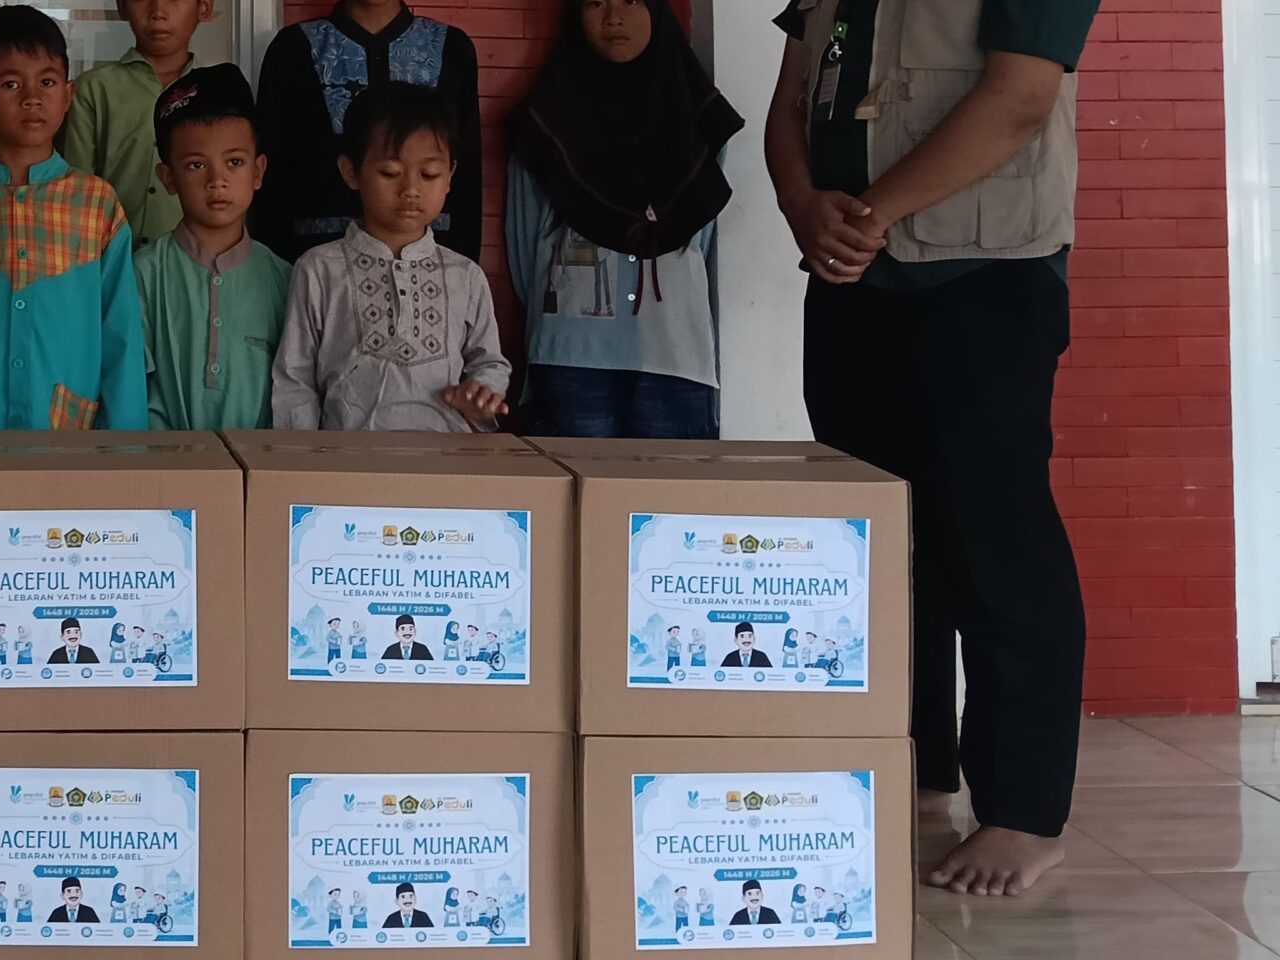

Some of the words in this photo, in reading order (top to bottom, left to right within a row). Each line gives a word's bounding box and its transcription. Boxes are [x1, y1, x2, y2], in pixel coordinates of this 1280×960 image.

[77, 570, 175, 590] MUHARAM
[311, 566, 404, 587] PEACEFUL
[412, 568, 510, 589] MUHARAM
[650, 574, 744, 594] PEACEFUL
[752, 576, 848, 596] MUHARAM
[8, 593, 53, 601] LEBARAN
[56, 593, 87, 601] YATIM
[99, 592, 141, 600] DIFABEL
[342, 589, 388, 597] LEBARAN
[391, 590, 422, 598] YATIM
[424, 590, 431, 598] &
[433, 591, 475, 599] DIFABEL
[682, 597, 728, 605] LEBARAN
[730, 598, 761, 606] YATIM
[763, 598, 770, 606] &
[773, 598, 814, 606] DIFABEL
[42, 608, 62, 616] 1448
[63, 608, 71, 616] H
[78, 608, 99, 616] 2026
[377, 604, 397, 612] 1448
[413, 605, 434, 613] 2026
[716, 612, 736, 620] 1448
[737, 612, 745, 620] H
[752, 612, 773, 620] 2026
[79, 830, 178, 850] MUHARAM
[655, 833, 750, 854] PEACEFUL
[757, 830, 855, 852] MUHARAM
[311, 836, 404, 856] PEACEFUL
[412, 835, 509, 855] MUHARAM
[8, 852, 54, 860] LEBARAN
[57, 852, 88, 860] YATIM
[90, 852, 97, 860] &
[100, 852, 142, 860] DIFABEL
[688, 856, 734, 864] LEBARAN
[737, 855, 767, 863] YATIM
[770, 854, 776, 862] &
[779, 853, 821, 862] DIFABEL
[343, 859, 388, 867] LEBARAN
[391, 858, 421, 866] YATIM
[433, 857, 474, 865] DIFABEL
[43, 867, 63, 875] 1448
[64, 867, 72, 875] H
[79, 867, 101, 875] 2026
[102, 867, 111, 875] M
[723, 870, 743, 878] 1448
[744, 870, 752, 878] H
[759, 869, 780, 877] 2026
[377, 873, 397, 881] 1448
[398, 873, 406, 881] H
[413, 872, 434, 880] 2026
[435, 872, 443, 880] M
